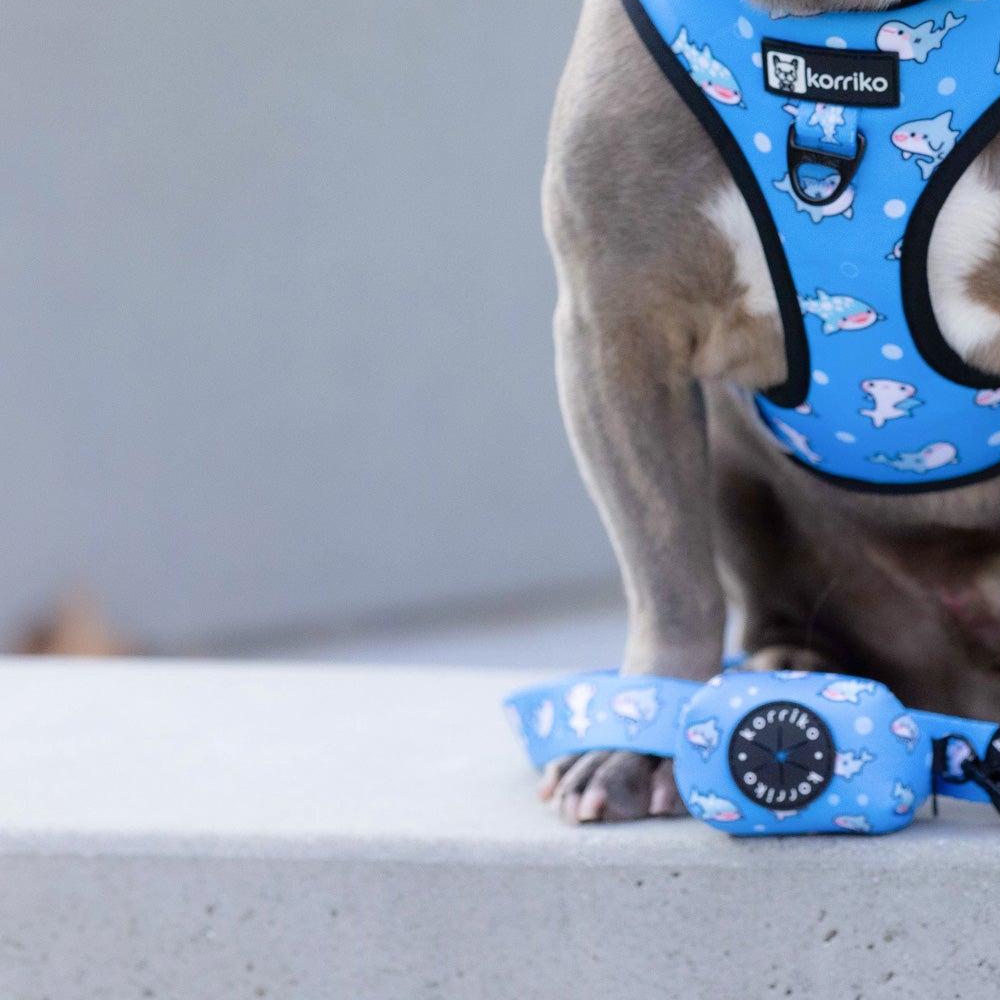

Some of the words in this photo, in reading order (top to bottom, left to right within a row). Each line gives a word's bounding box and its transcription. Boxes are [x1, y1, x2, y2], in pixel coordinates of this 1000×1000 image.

[806, 67, 888, 93] korriko
[738, 708, 820, 742] korriko
[743, 770, 825, 803] korriko
